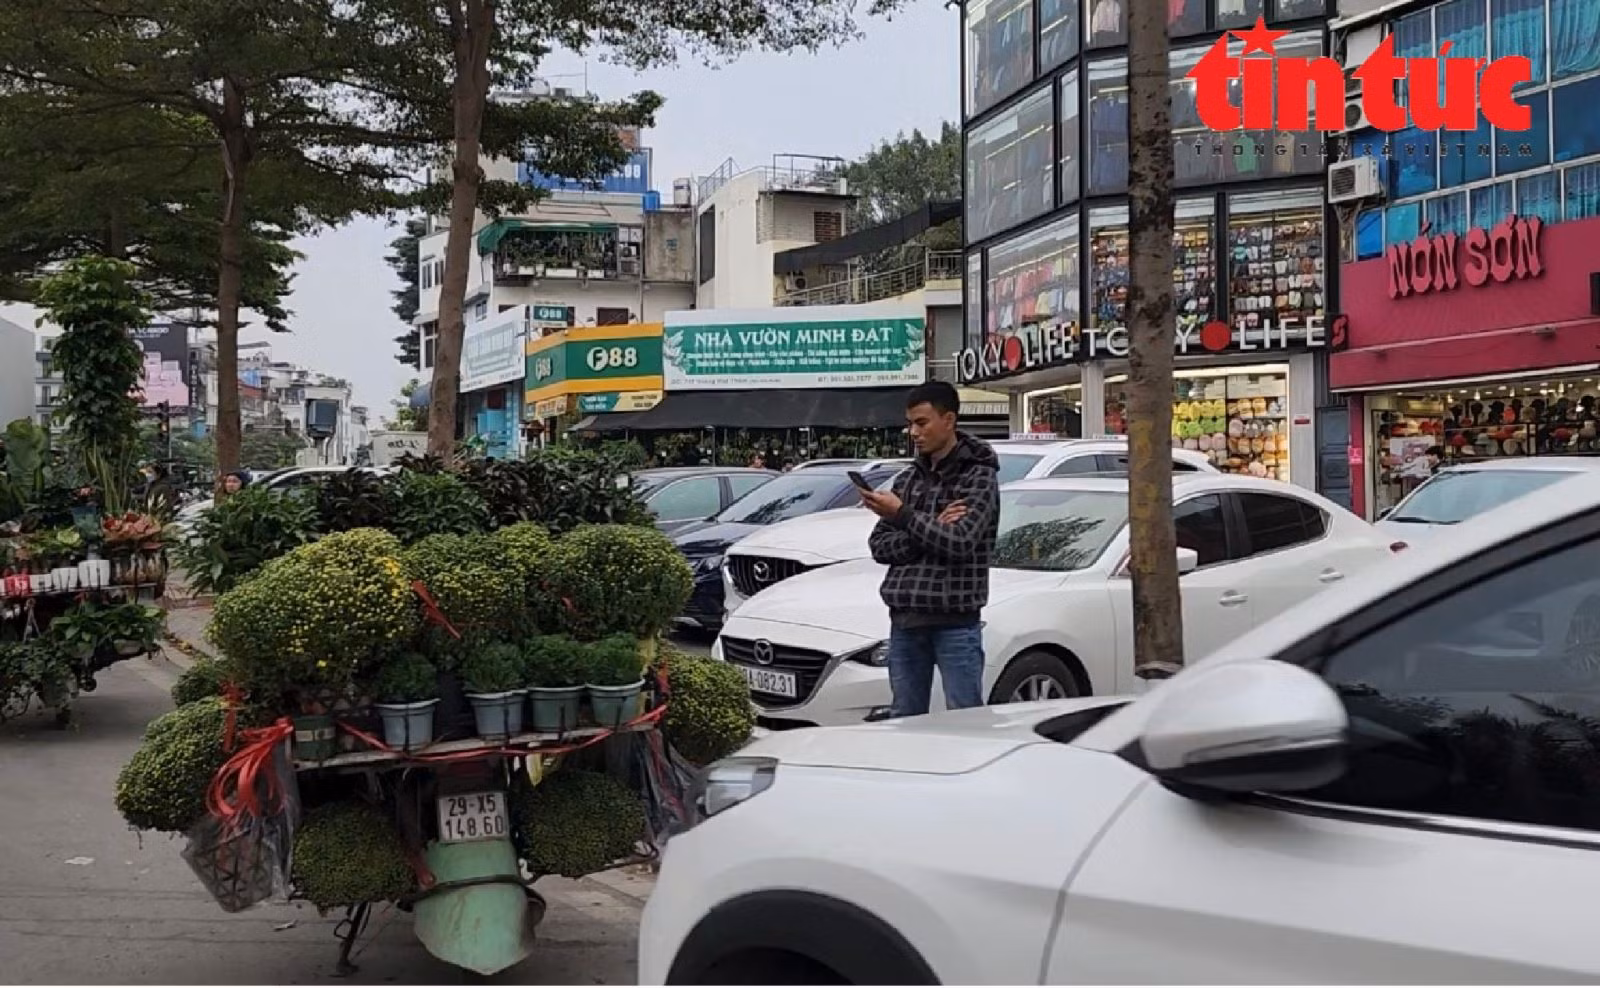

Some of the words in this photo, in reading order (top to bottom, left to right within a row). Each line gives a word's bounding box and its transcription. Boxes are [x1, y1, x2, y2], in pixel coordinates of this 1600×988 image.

[1387, 221, 1457, 299] NÓN
[694, 327, 734, 347] NHÀ
[794, 328, 846, 344] MINH
[850, 326, 894, 346] ĐẠT
[586, 346, 638, 371] F88
[447, 793, 496, 817] 29-X5
